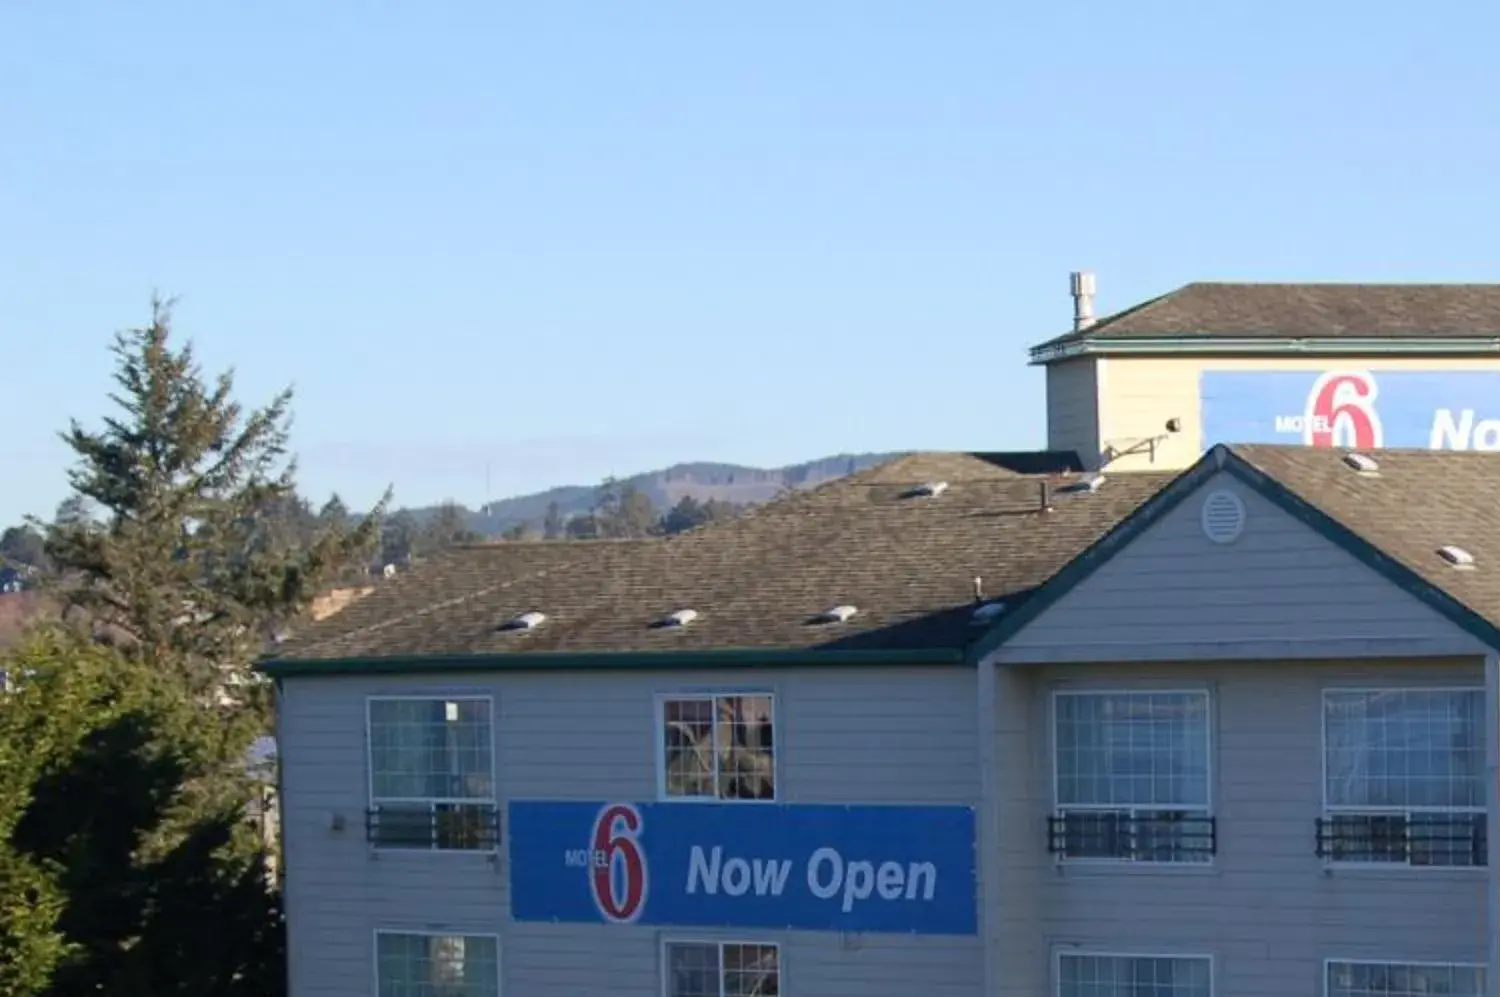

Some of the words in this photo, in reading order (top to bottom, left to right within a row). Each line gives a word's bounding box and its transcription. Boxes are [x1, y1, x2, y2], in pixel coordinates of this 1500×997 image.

[1306, 371, 1382, 448] 6
[590, 804, 648, 921] 6
[687, 847, 791, 896] Now
[807, 848, 935, 911] Open
